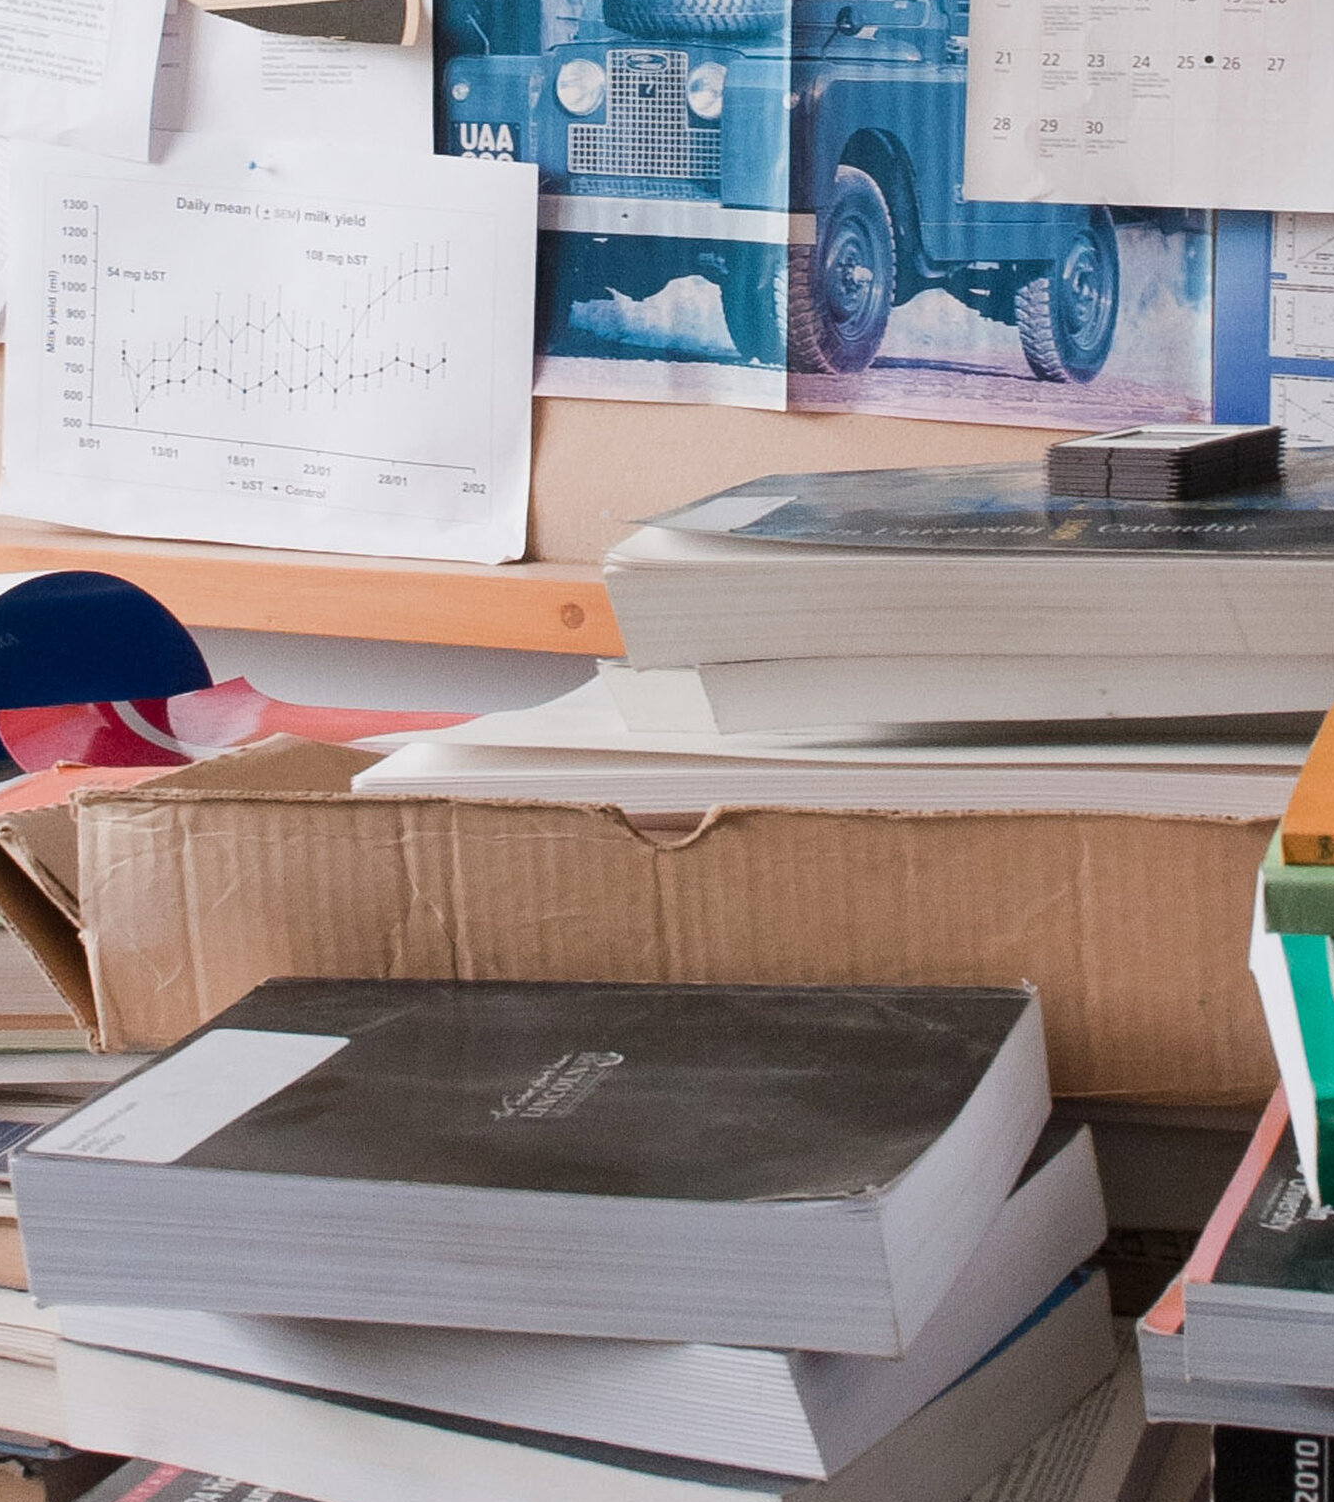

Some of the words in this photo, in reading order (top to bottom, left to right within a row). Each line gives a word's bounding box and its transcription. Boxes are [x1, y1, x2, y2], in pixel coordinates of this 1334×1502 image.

[459, 123, 514, 152] UAA
[61, 199, 89, 211] 1300
[175, 197, 211, 215] Daily
[213, 201, 252, 214] mean
[304, 209, 332, 225] milk
[333, 211, 367, 229] yield
[61, 227, 89, 239] 1200
[61, 254, 88, 267] 1100
[305, 249, 324, 262] 108
[326, 253, 345, 267] mg
[346, 253, 369, 266] bST
[48, 270, 60, 291] (ml)
[106, 266, 120, 278] 54
[123, 271, 141, 283] mg
[142, 269, 166, 282] bST
[60, 282, 88, 294] 1000
[46, 293, 60, 325] yield
[66, 309, 87, 321] 900
[45, 327, 57, 354] Milk
[65, 336, 86, 348] 800
[64, 364, 85, 376] 700
[63, 391, 84, 403] 600
[62, 418, 83, 430] 500
[78, 437, 101, 450] 8/01
[151, 446, 179, 460] 13/01
[227, 455, 255, 469] 18/01
[302, 464, 331, 478] 23/01
[378, 473, 408, 487] 28/01
[462, 482, 487, 495] 2/02
[241, 479, 264, 492] bST
[285, 483, 326, 499] Control
[1098, 521, 1257, 535] Calendar
